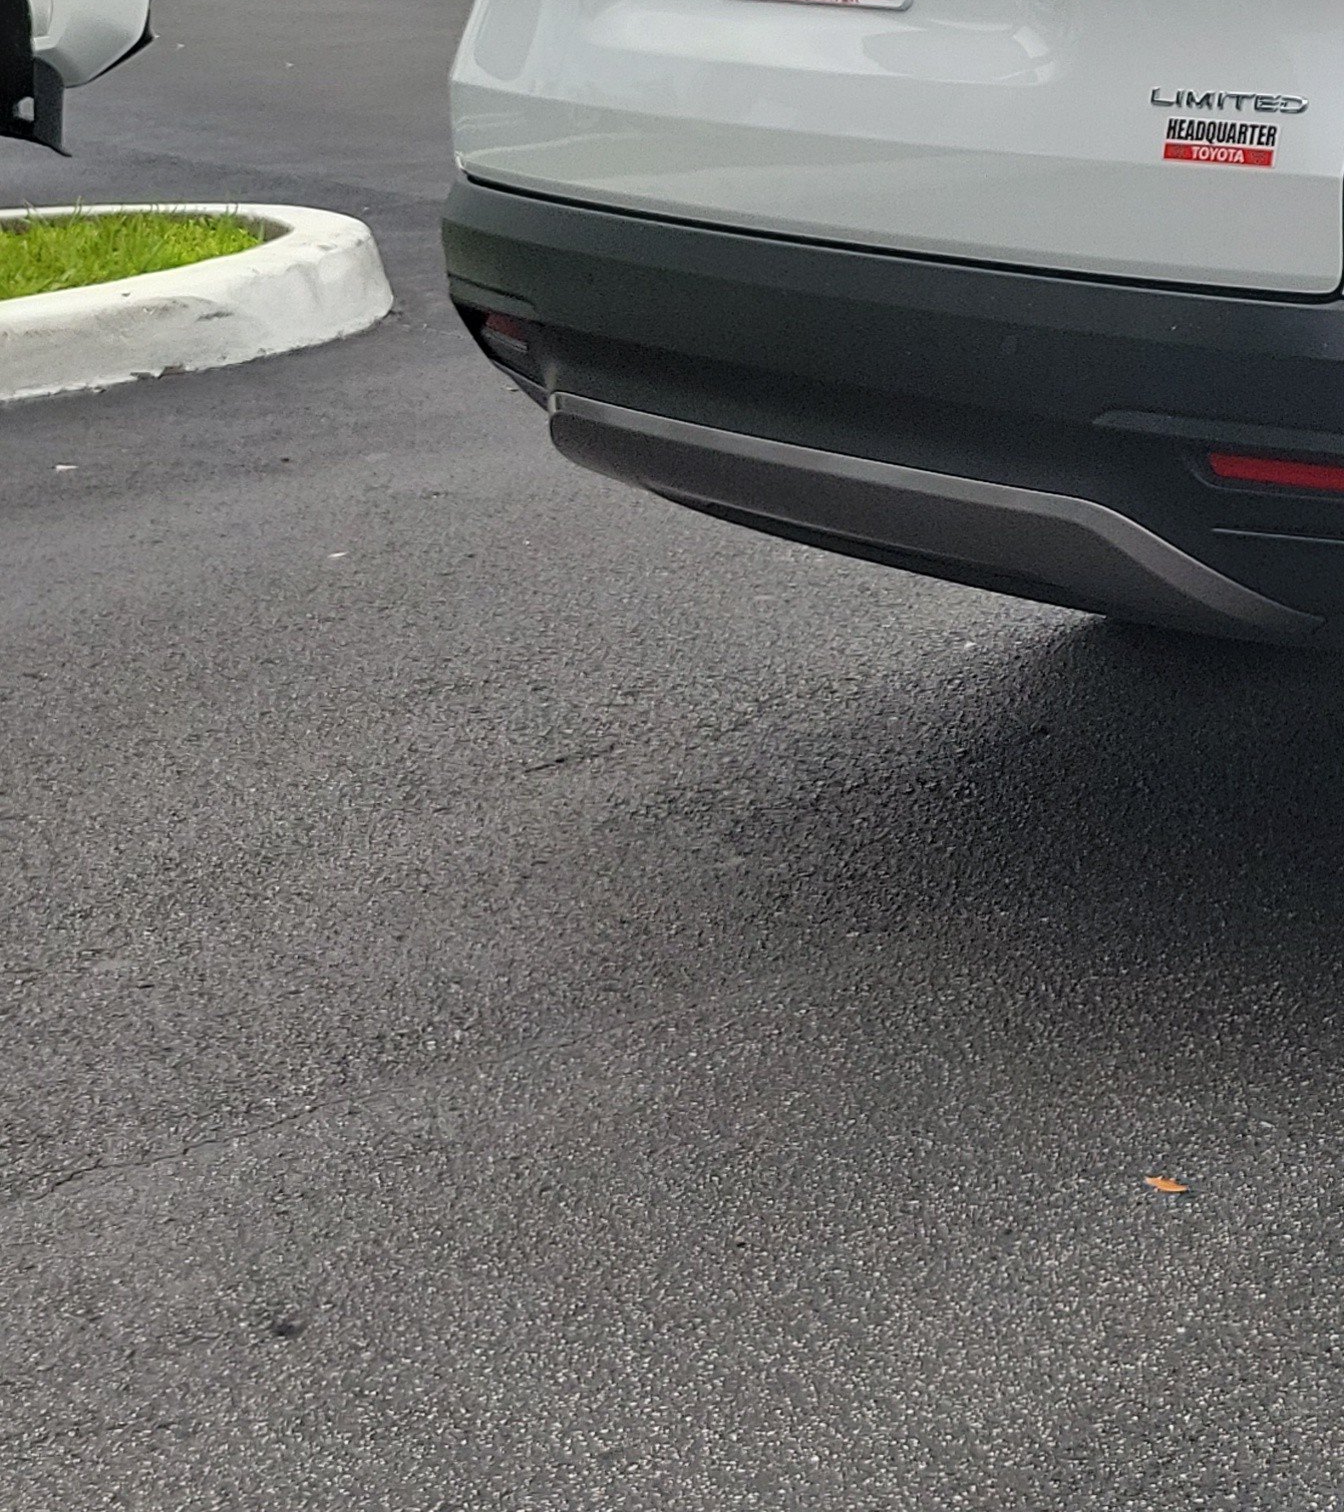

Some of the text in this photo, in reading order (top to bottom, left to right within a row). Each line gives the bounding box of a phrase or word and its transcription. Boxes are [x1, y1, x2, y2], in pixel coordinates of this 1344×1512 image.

[1150, 87, 1309, 115] LIMITED
[1166, 117, 1278, 147] HEADQUARTER
[1190, 145, 1245, 164] TOYOTA
